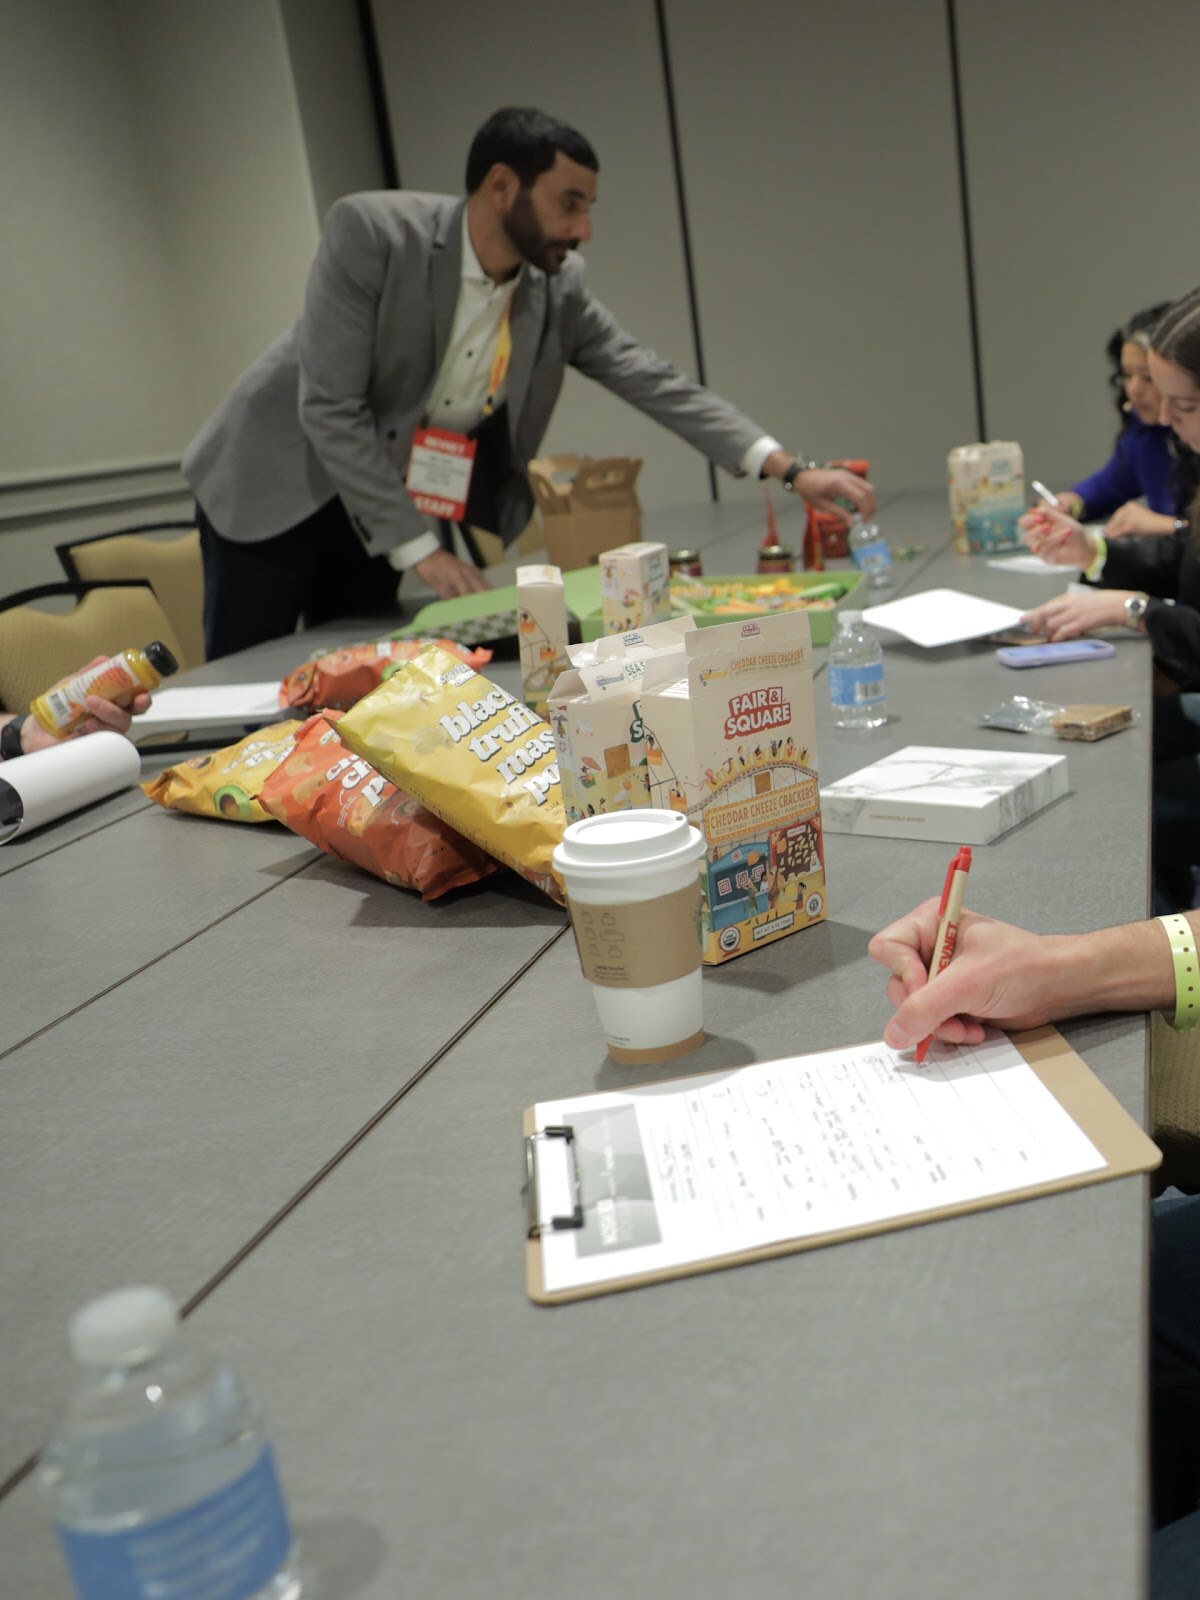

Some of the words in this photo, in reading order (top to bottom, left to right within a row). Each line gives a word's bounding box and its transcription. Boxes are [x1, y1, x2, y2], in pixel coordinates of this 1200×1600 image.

[625, 664, 641, 676] SEA
[731, 690, 768, 716] FAIR
[725, 704, 791, 736] SQUARE
[711, 807, 748, 829] CHEDDAR
[750, 800, 778, 817] CHEEZE
[779, 786, 814, 808] CRACKERS
